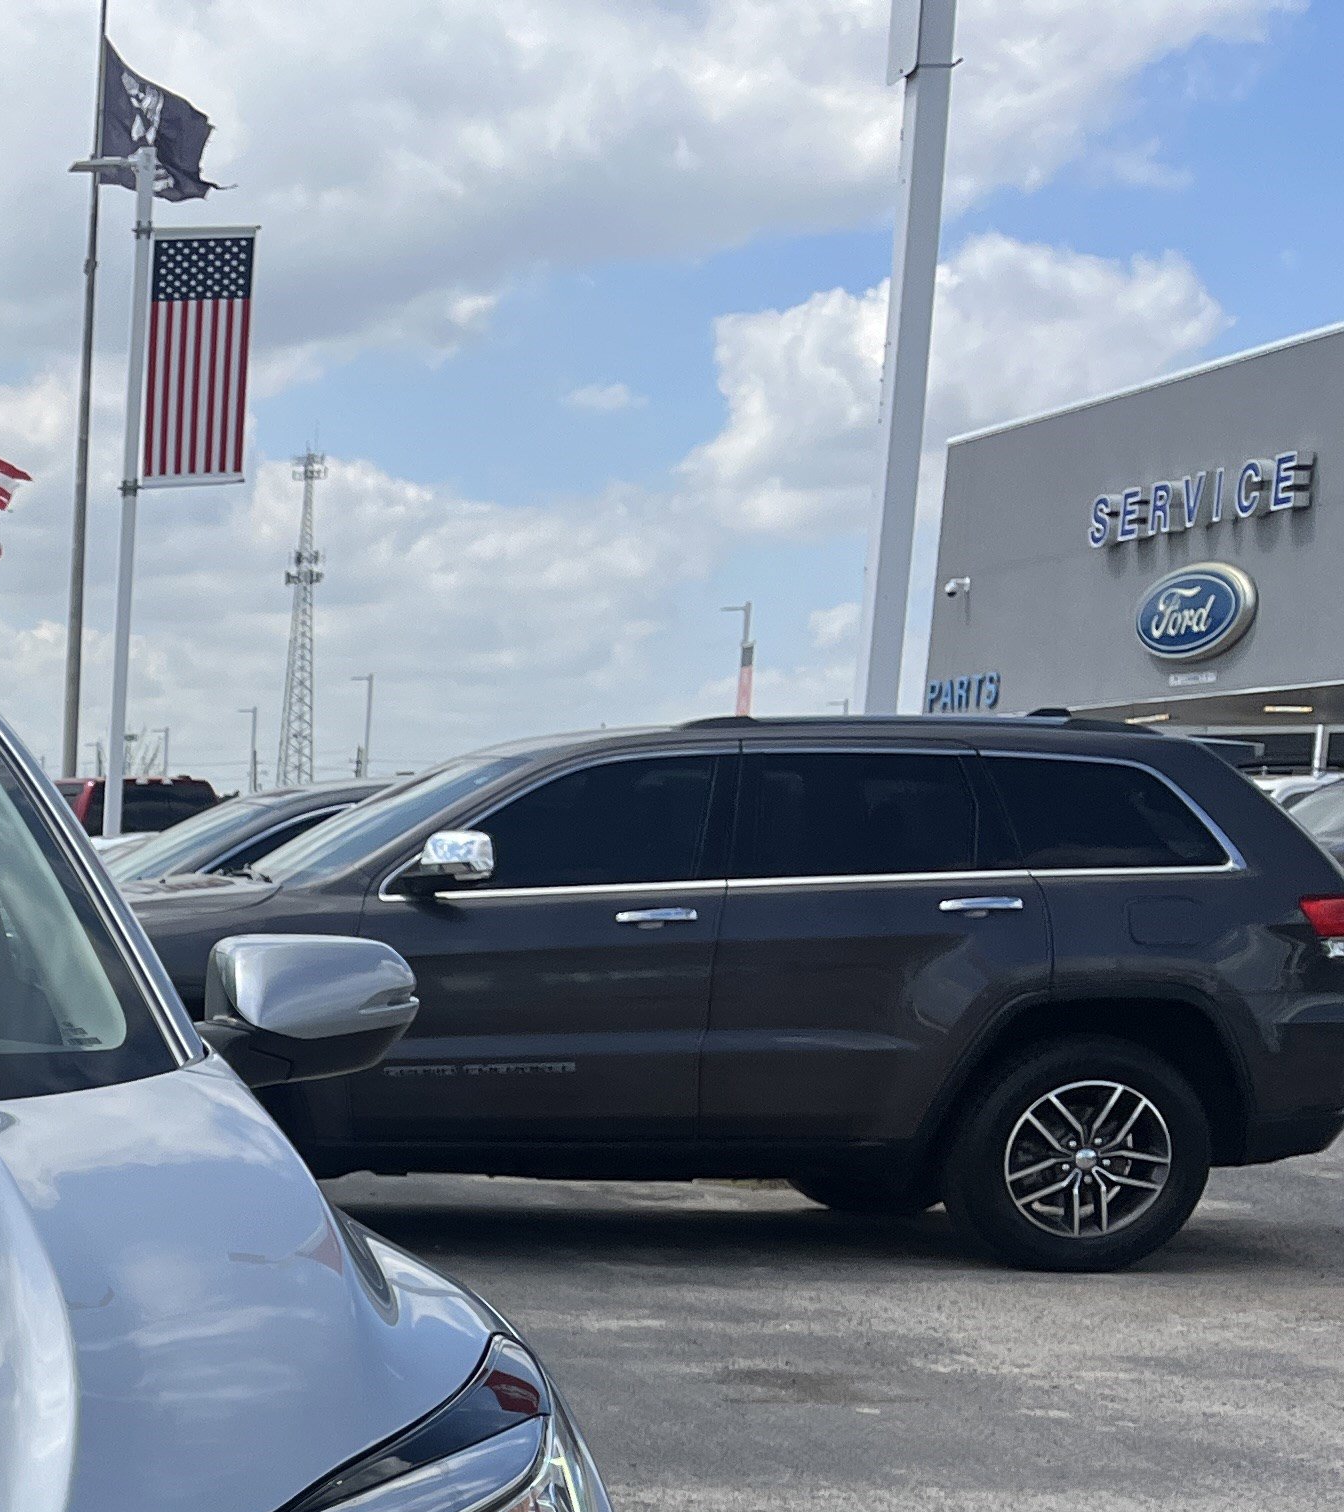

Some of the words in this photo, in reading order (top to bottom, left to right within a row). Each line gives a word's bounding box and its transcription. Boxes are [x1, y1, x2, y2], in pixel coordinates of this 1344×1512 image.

[1088, 451, 1298, 548] SERVICE
[1151, 585, 1217, 640] Ford
[928, 671, 1001, 713] PARTS
